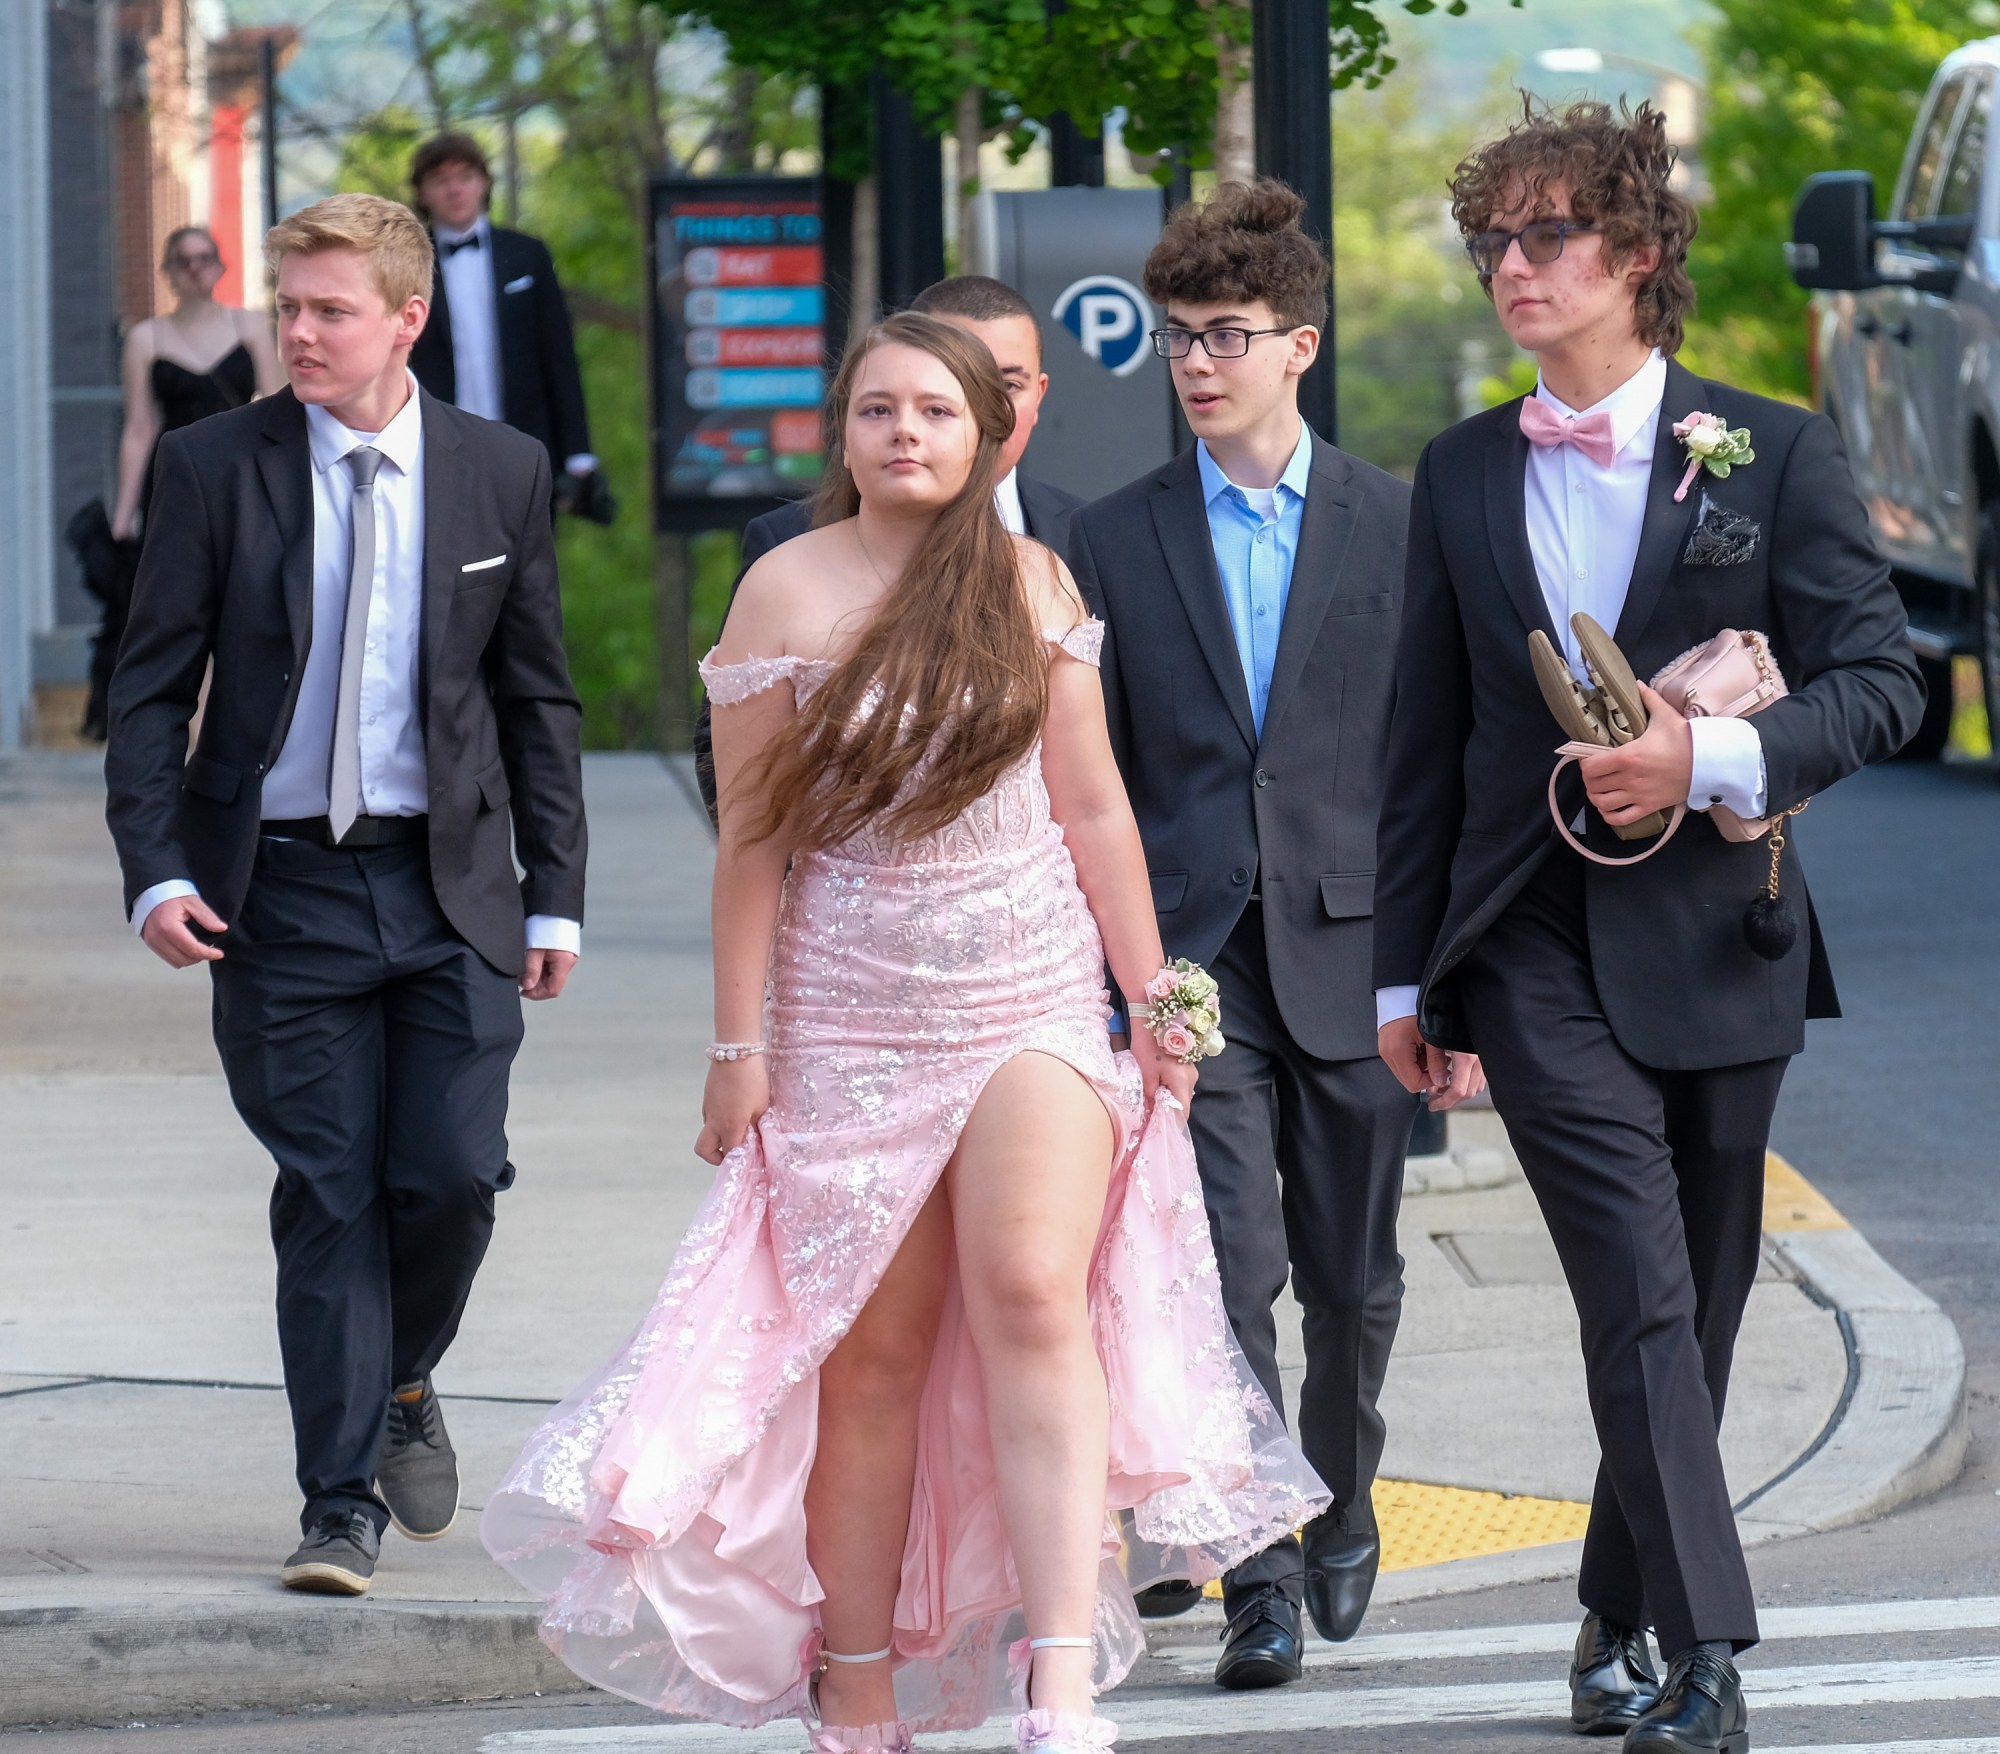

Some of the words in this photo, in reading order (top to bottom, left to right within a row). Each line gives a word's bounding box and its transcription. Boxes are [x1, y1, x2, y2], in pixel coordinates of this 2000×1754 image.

[674, 215, 777, 241] THINGS
[781, 214, 822, 240] TO
[1080, 295, 1136, 359] P
